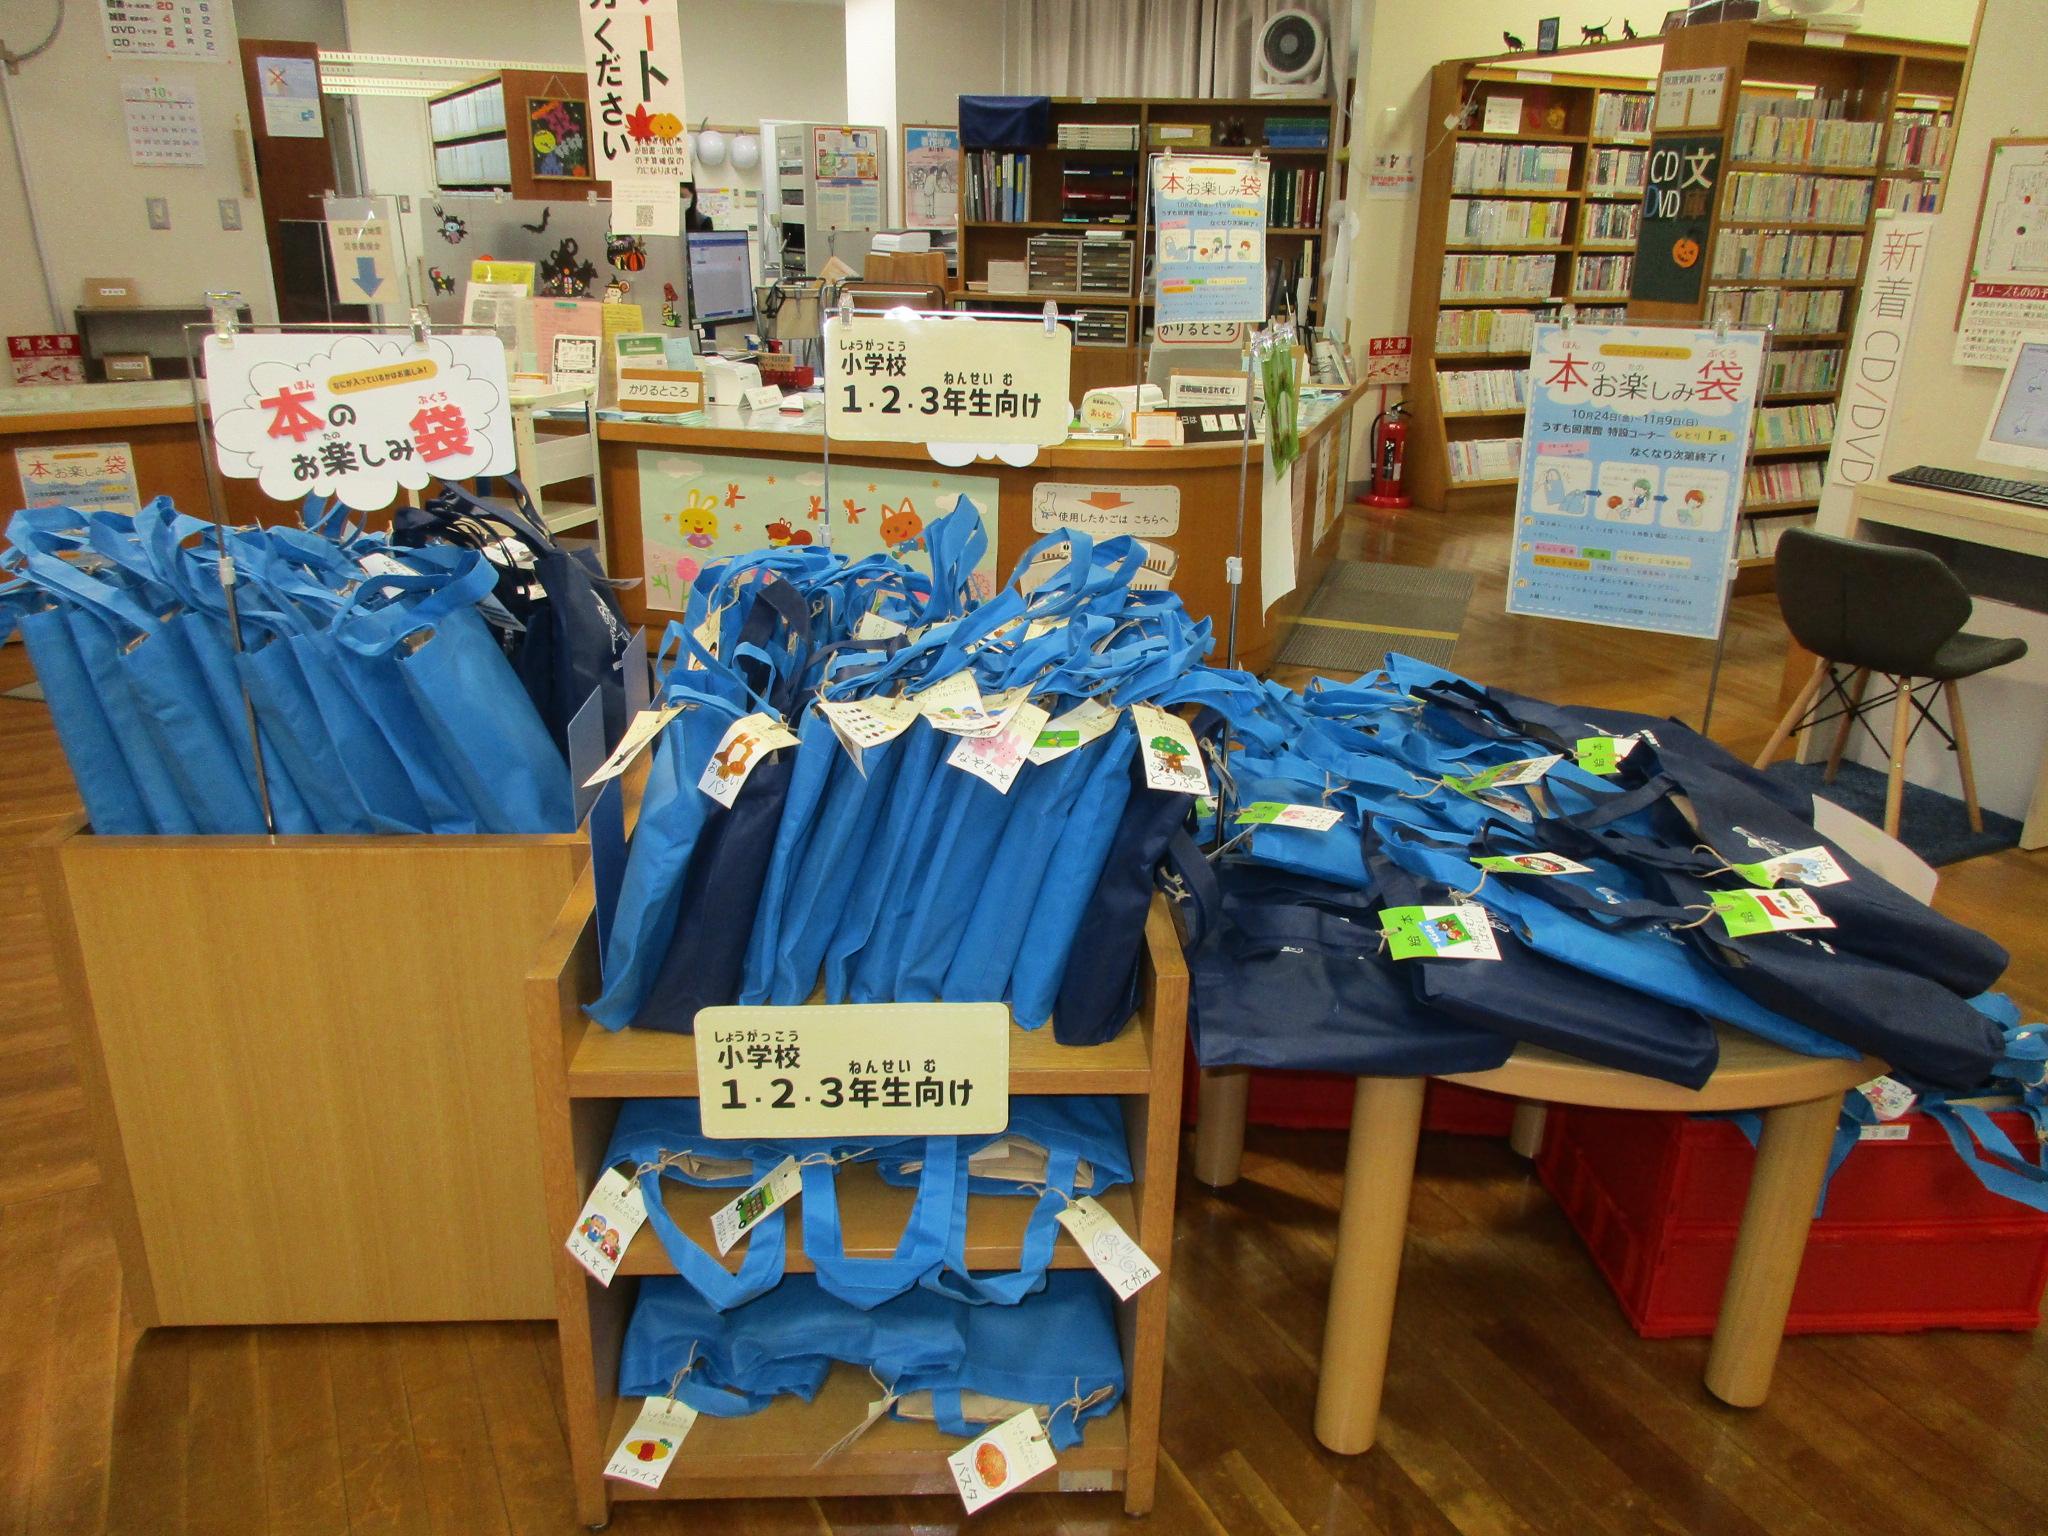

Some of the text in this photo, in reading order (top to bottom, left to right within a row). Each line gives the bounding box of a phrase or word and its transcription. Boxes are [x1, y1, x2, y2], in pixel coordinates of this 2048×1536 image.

[636, 0, 670, 103] ート
[590, 0, 631, 161] ください
[1650, 150, 1679, 184] CD
[1643, 184, 1680, 218] DVD
[1161, 323, 1235, 336] かりるところ
[16, 336, 74, 350] 消火器
[840, 338, 907, 352] しょうがっこう
[1373, 338, 1407, 350] 消火器
[841, 352, 907, 377] 小学校
[1545, 352, 1744, 402] 本のお楽しみ袋
[418, 391, 448, 405] ぶくろ
[628, 384, 690, 398] かりるところ
[1176, 414, 1198, 426] 日は
[1057, 511, 1128, 524] 使用したかごは
[714, 1030, 799, 1043] しょうがっこう
[717, 1044, 801, 1070] 小学校
[608, 1463, 660, 1483] オムライス
